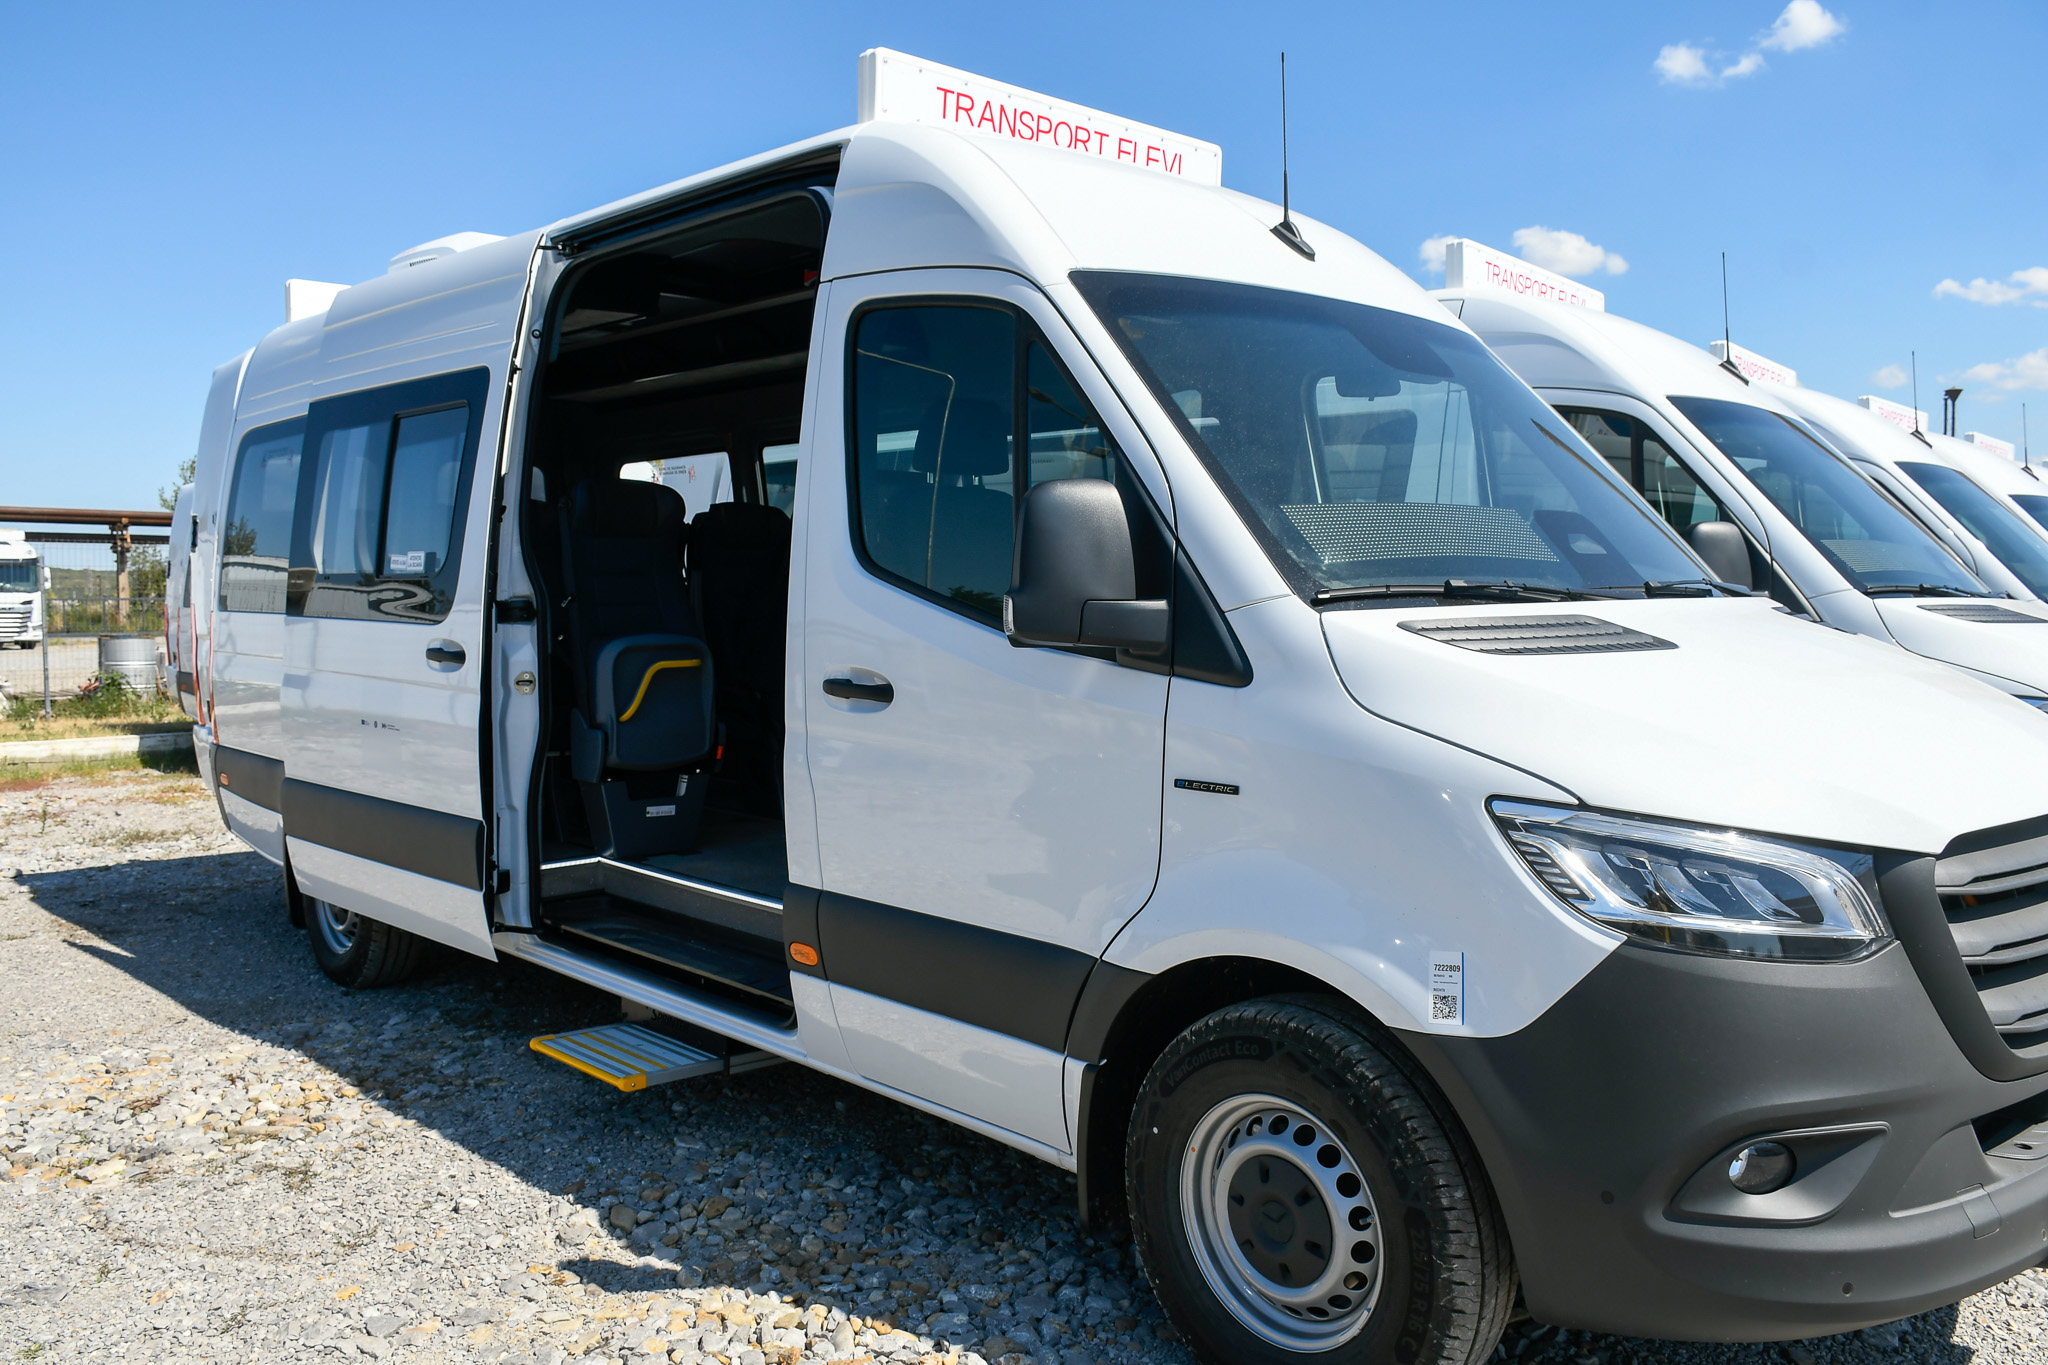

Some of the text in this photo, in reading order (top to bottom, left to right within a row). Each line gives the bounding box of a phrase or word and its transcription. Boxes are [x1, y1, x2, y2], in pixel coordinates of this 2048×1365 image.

[936, 86, 1109, 156] TRANSPORT
[1485, 261, 1555, 298] TRANSPORT
[1433, 964, 1461, 972] 7222809
[1166, 1039, 1260, 1087] VanContact Eco
